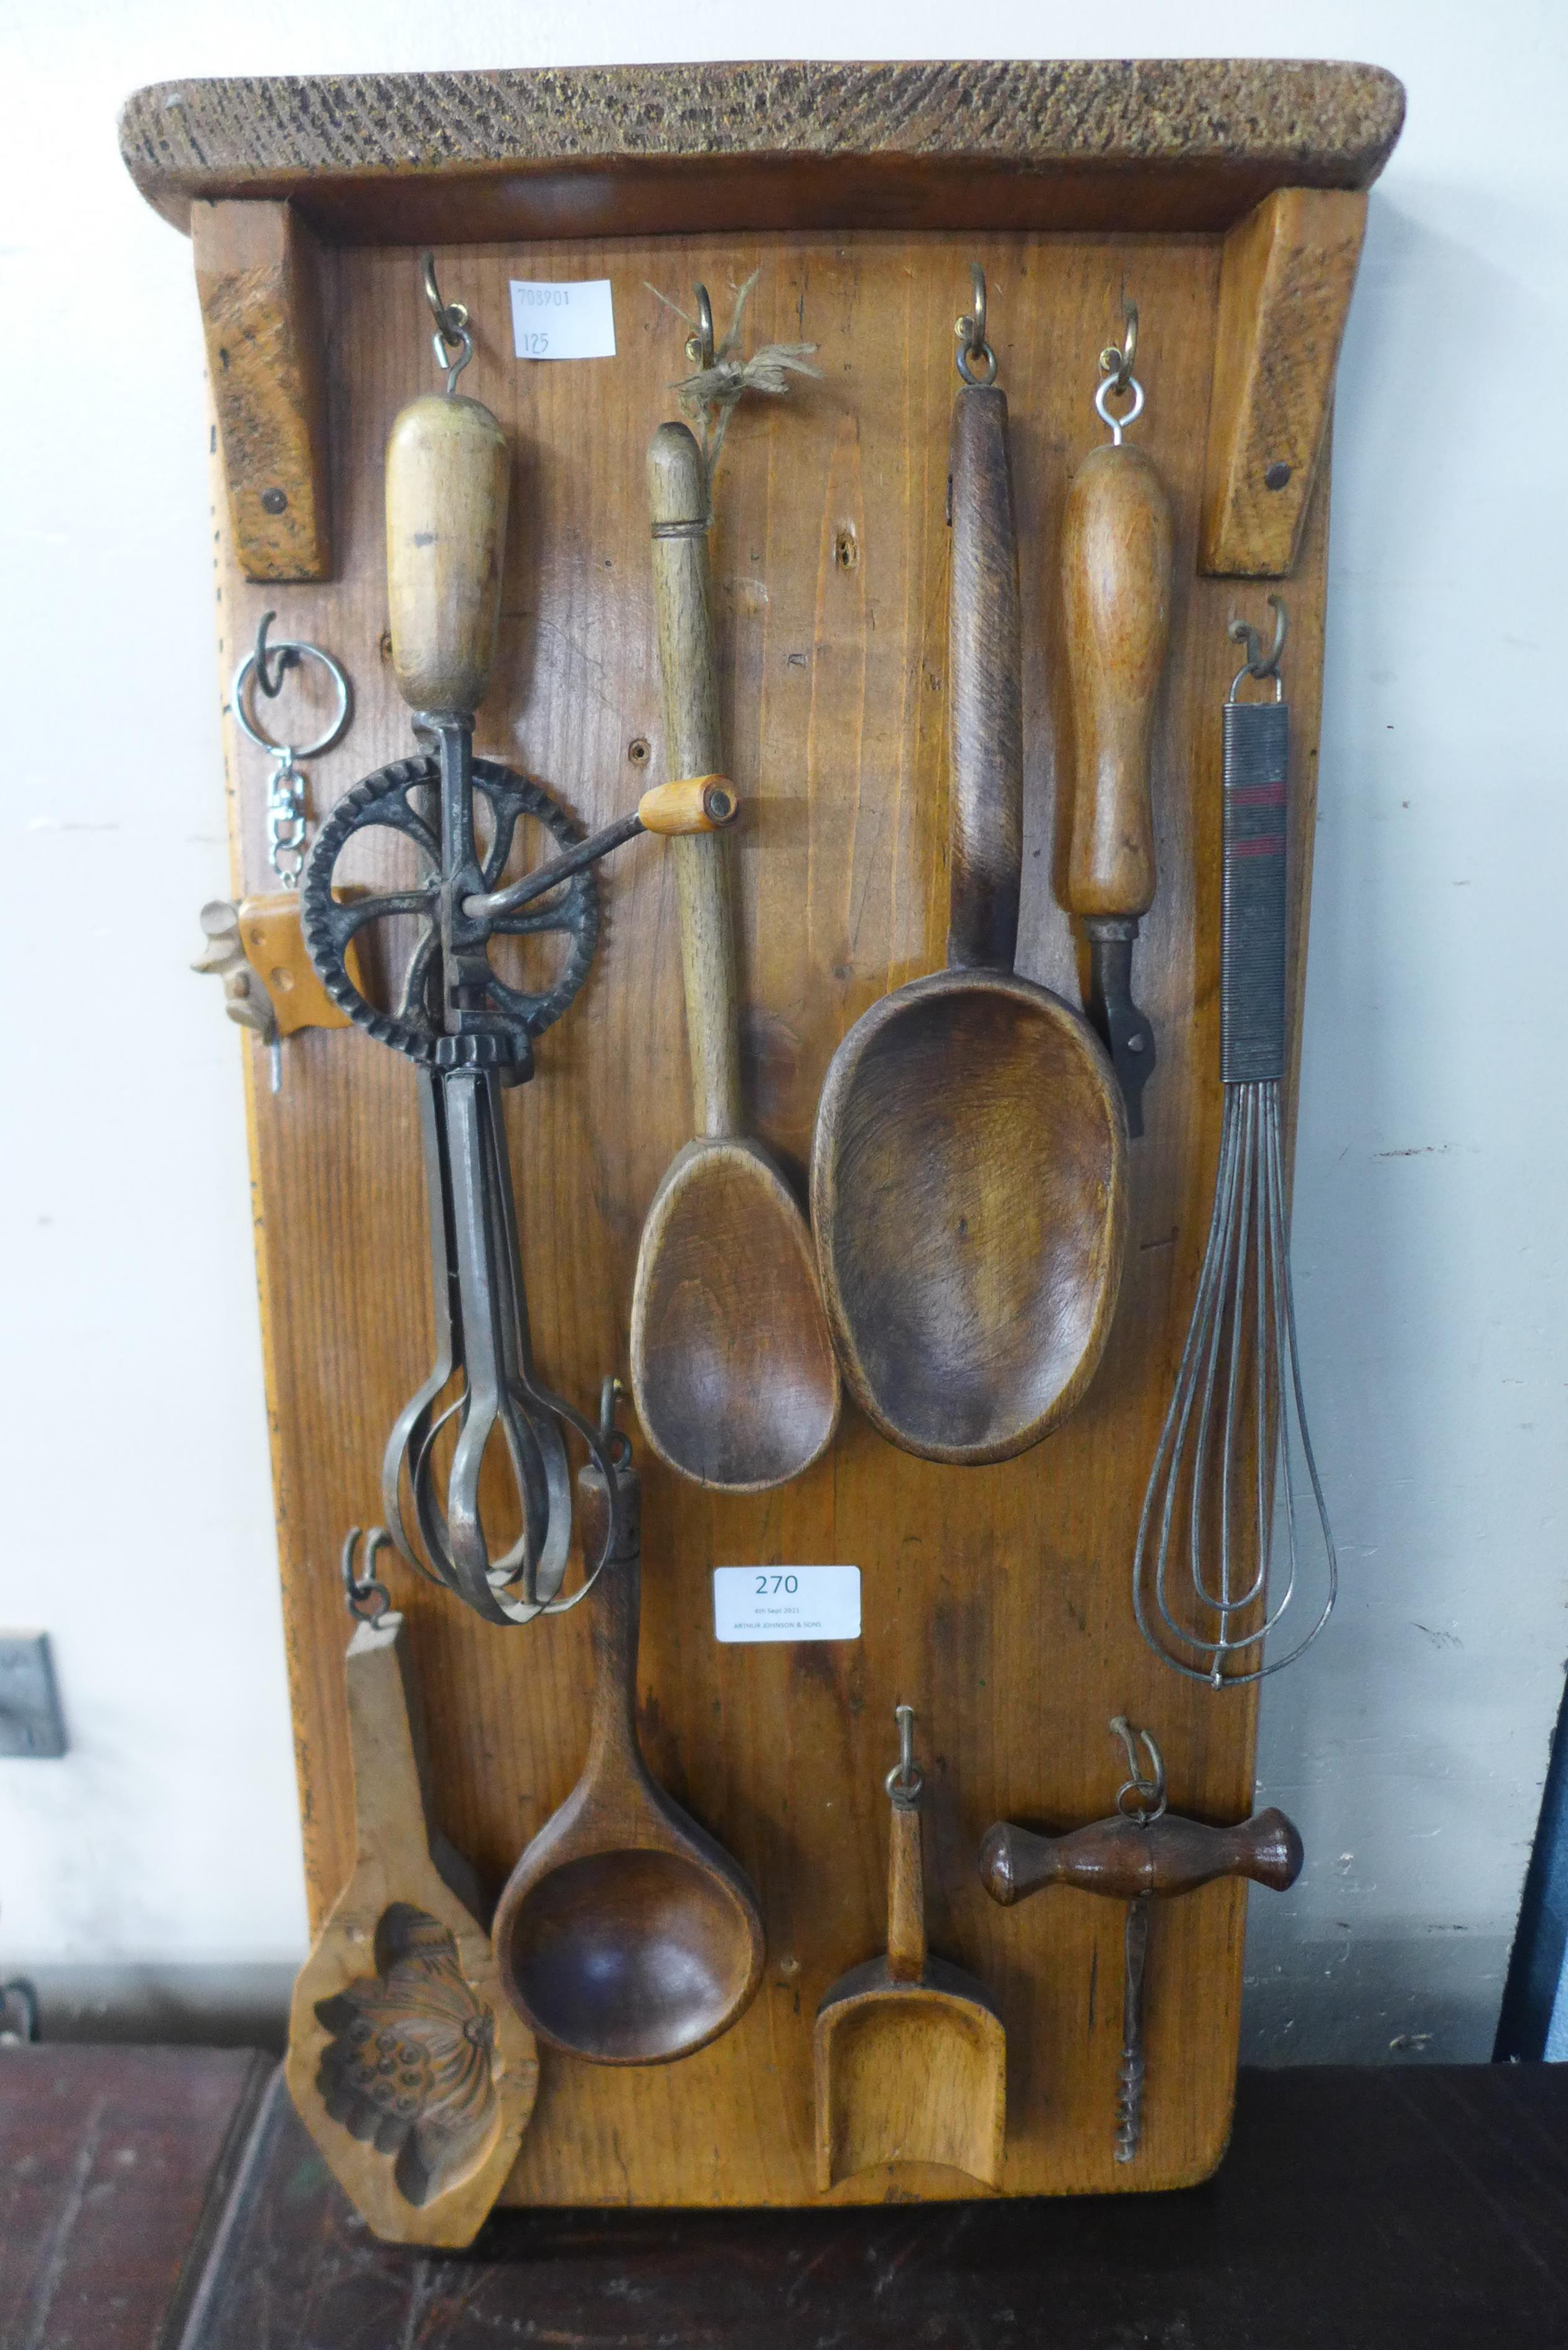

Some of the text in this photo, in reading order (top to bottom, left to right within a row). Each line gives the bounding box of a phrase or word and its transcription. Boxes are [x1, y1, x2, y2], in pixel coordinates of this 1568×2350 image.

[518, 289, 569, 306] 708901
[524, 334, 548, 354] 125
[756, 1575, 798, 1594] 270
